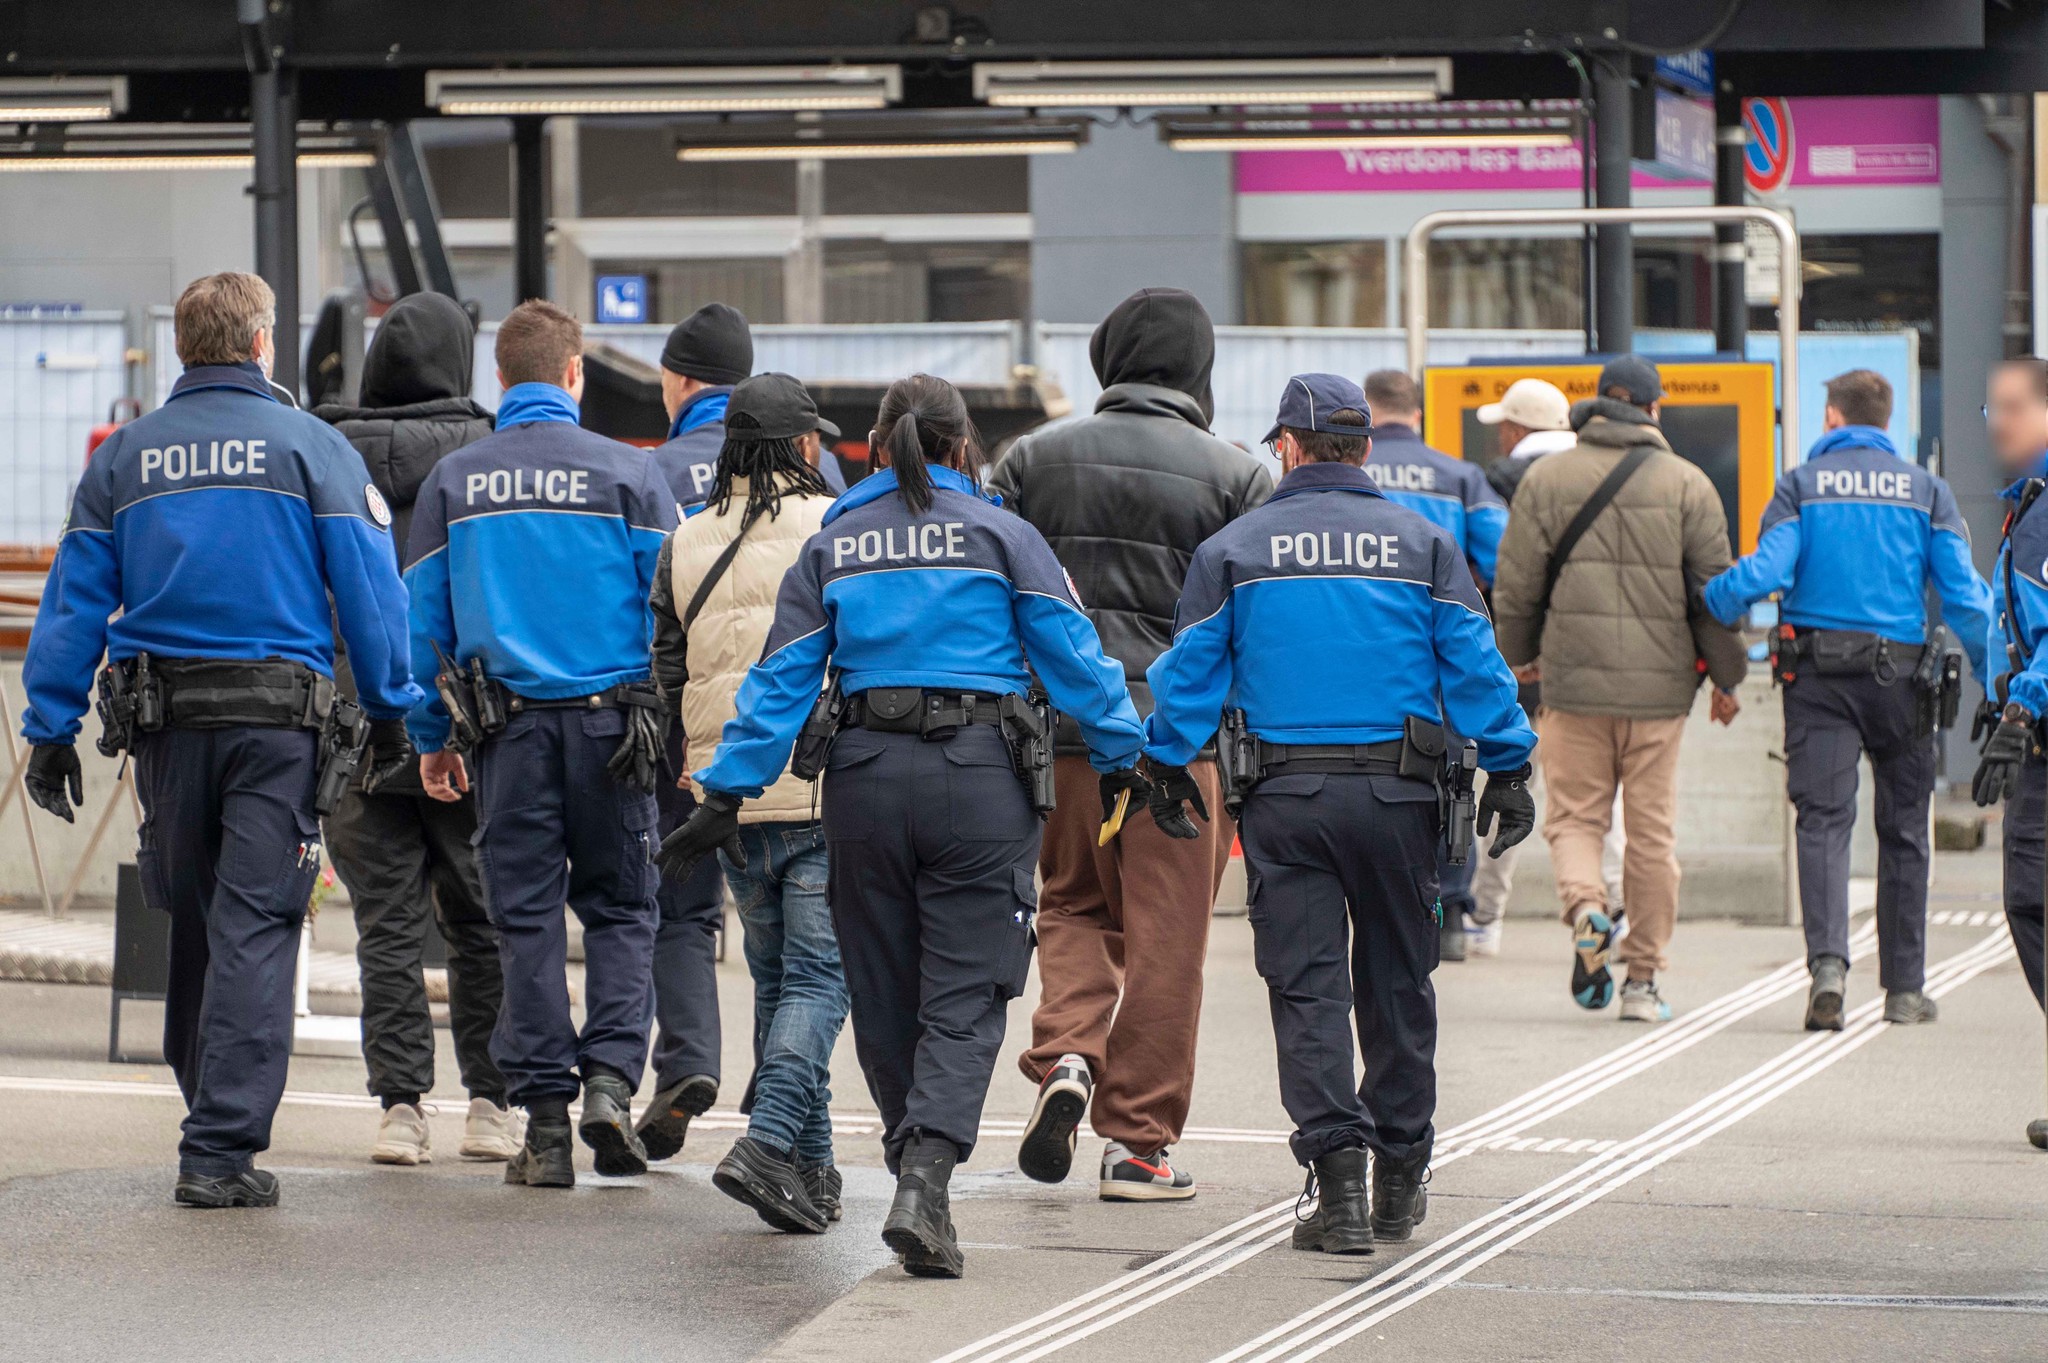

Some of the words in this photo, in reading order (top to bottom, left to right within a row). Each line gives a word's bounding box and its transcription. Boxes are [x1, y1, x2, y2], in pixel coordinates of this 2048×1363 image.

[1341, 147, 1585, 174] Yverdon-les-Bain
[140, 439, 267, 484] POLICE
[1363, 463, 1436, 490] OLICE
[466, 469, 589, 506] POLICE
[1816, 469, 1912, 499] POLICE
[834, 522, 966, 569] POLICE
[1271, 532, 1399, 568] POLICE
